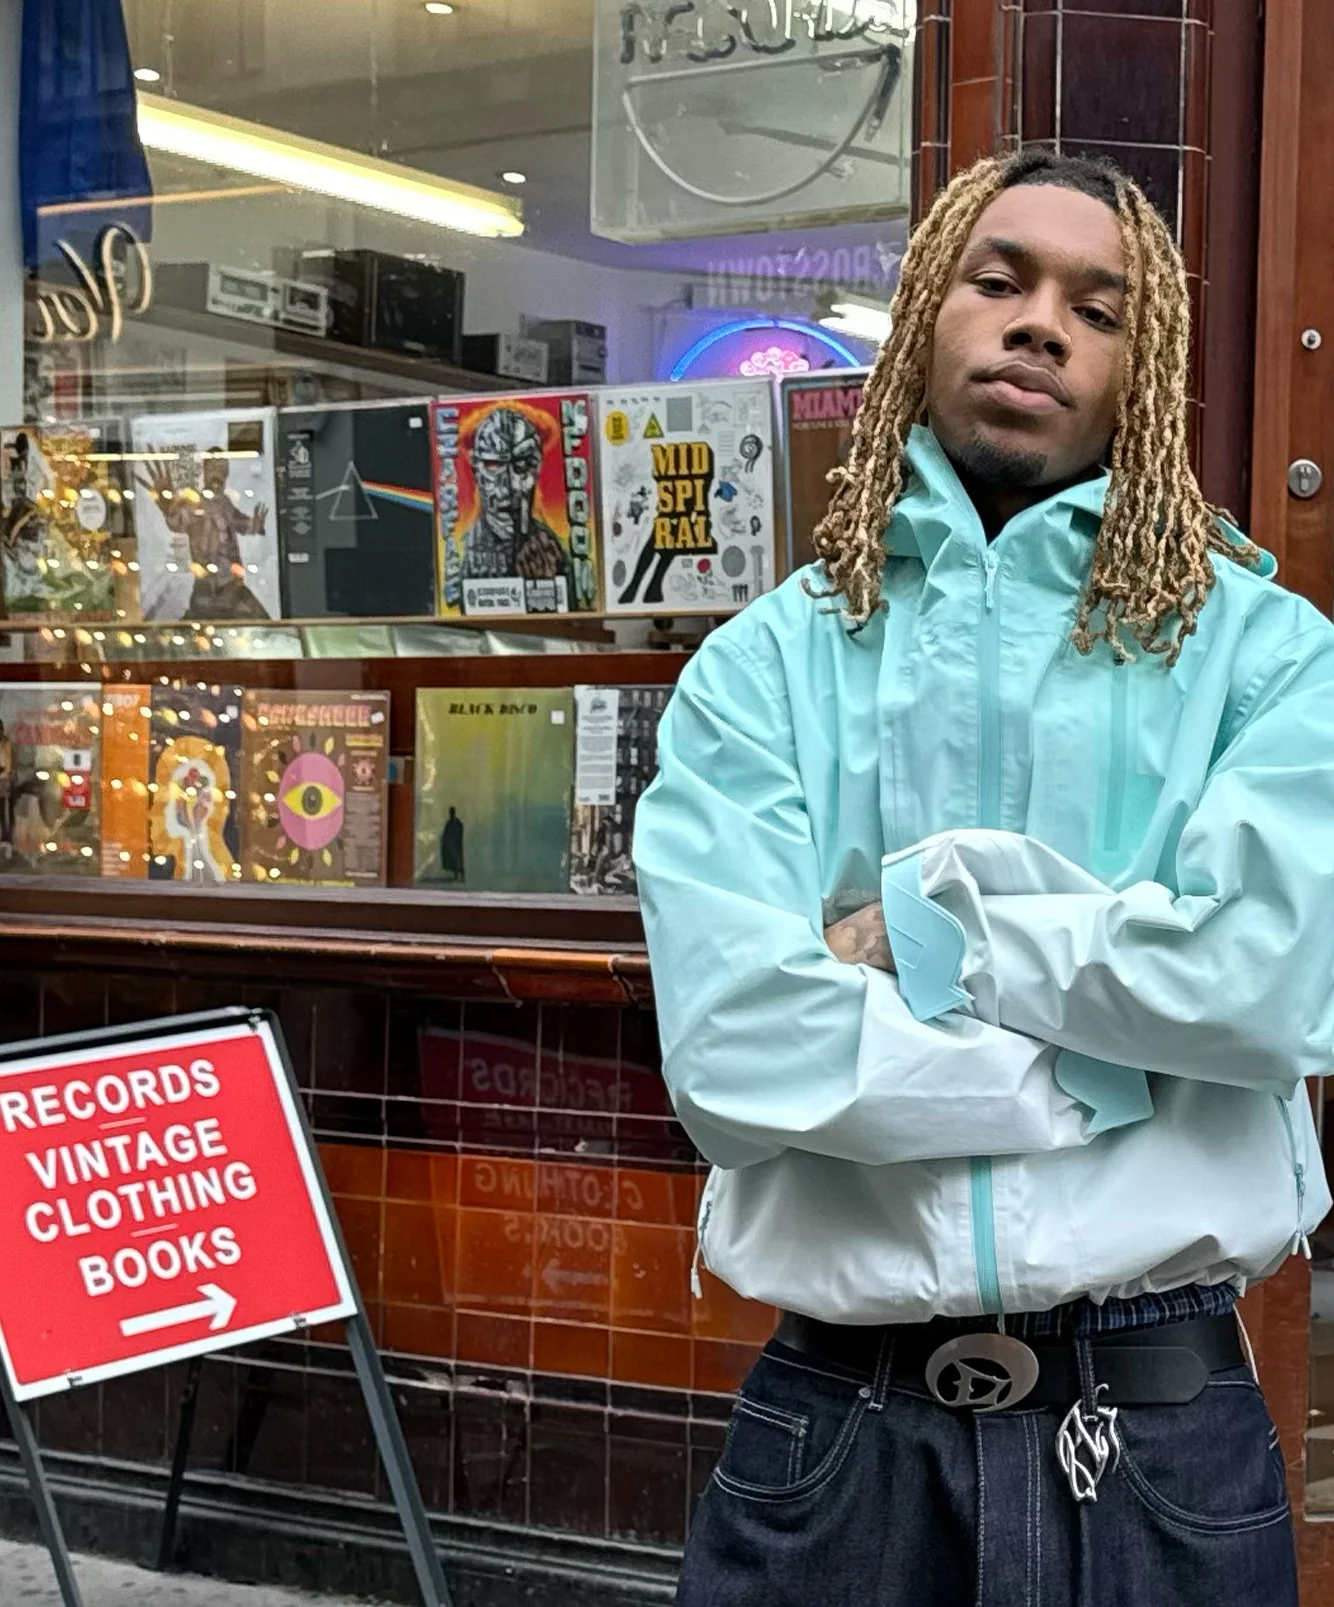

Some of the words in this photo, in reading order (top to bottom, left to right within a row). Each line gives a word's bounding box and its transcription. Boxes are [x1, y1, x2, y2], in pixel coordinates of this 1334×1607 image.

[792, 387, 864, 420] MIAM
[650, 441, 711, 477] MID
[656, 479, 706, 513] SPI
[653, 513, 714, 551] RAL
[0, 1058, 221, 1133] RECORDS
[25, 1117, 228, 1190] VINTAGE
[25, 1161, 257, 1243] CLOTHING
[79, 1226, 241, 1297] BOOKS
